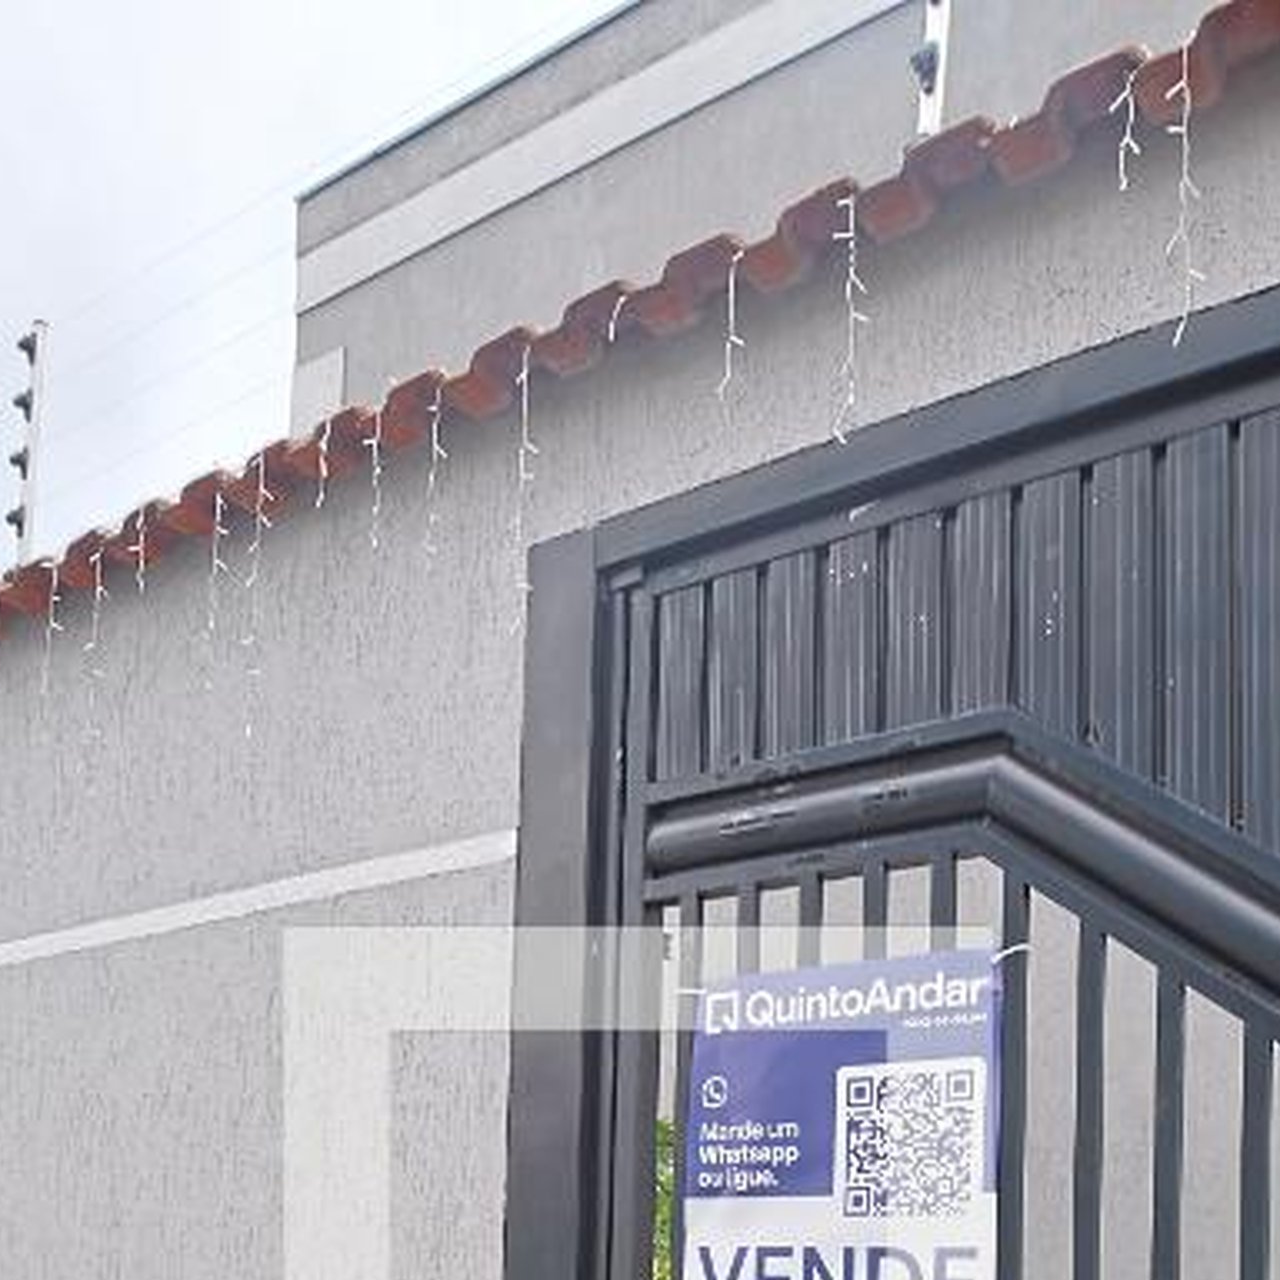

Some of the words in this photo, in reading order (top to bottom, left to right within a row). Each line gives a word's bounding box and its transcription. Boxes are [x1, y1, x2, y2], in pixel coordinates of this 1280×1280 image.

[745, 971, 988, 1025] QuintoAndar
[699, 1119, 764, 1141] Mande
[767, 1122, 800, 1138] um
[698, 1144, 800, 1167] Whatsapp
